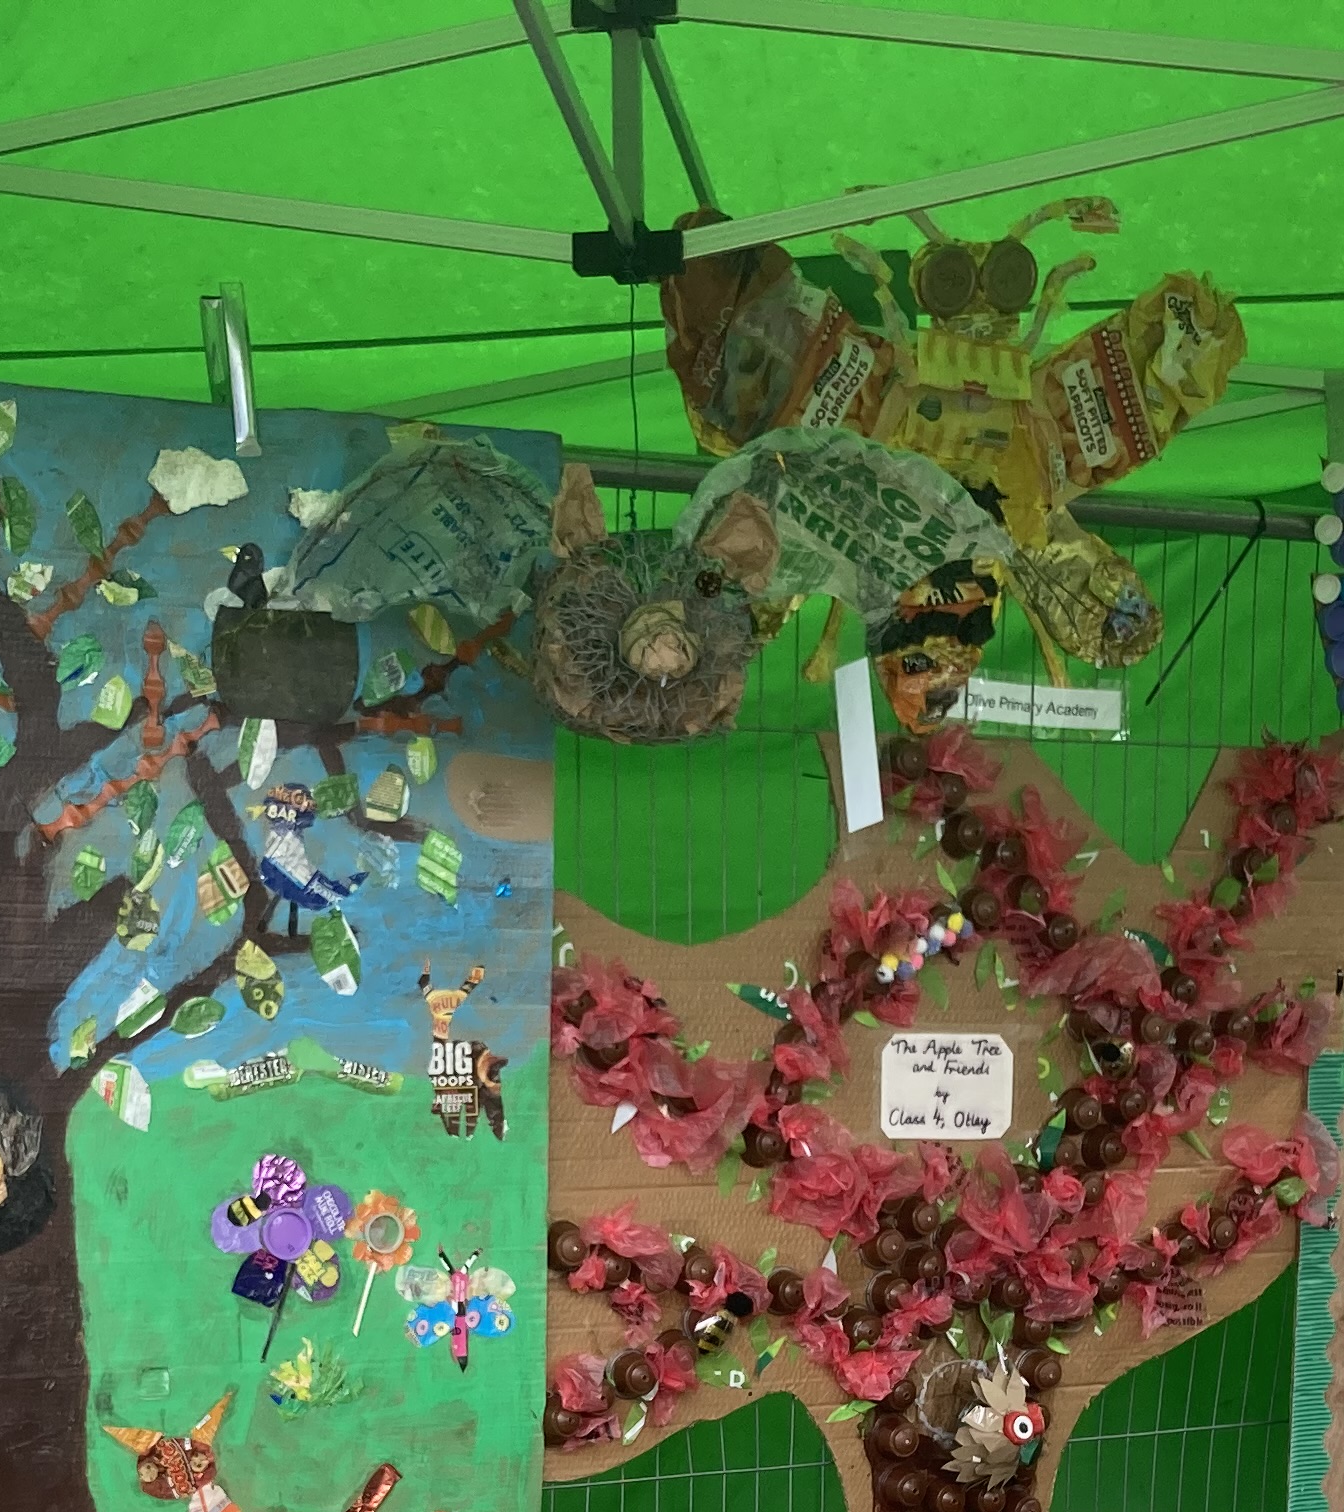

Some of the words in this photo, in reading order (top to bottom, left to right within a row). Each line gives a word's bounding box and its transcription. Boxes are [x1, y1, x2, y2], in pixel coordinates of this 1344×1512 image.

[810, 392, 834, 428] SOFT
[832, 344, 860, 392] PITTED
[827, 361, 869, 428] APRICOTS
[1067, 385, 1097, 453] APRICOTS
[1075, 368, 1094, 406] SOFT
[1089, 403, 1107, 456] PITTED
[966, 693, 996, 710] Olive
[999, 696, 1043, 716] Primary
[1046, 699, 1098, 720] Academy
[267, 804, 298, 823] BAR
[428, 1041, 474, 1076] BIG
[891, 1039, 918, 1055] The
[923, 1039, 963, 1060] Apple
[971, 1039, 1002, 1056] Tree
[912, 1061, 936, 1073] and
[944, 1060, 990, 1075] Friends
[934, 1086, 951, 1104] by
[889, 1107, 926, 1126] Class
[954, 1111, 992, 1135] Otley
